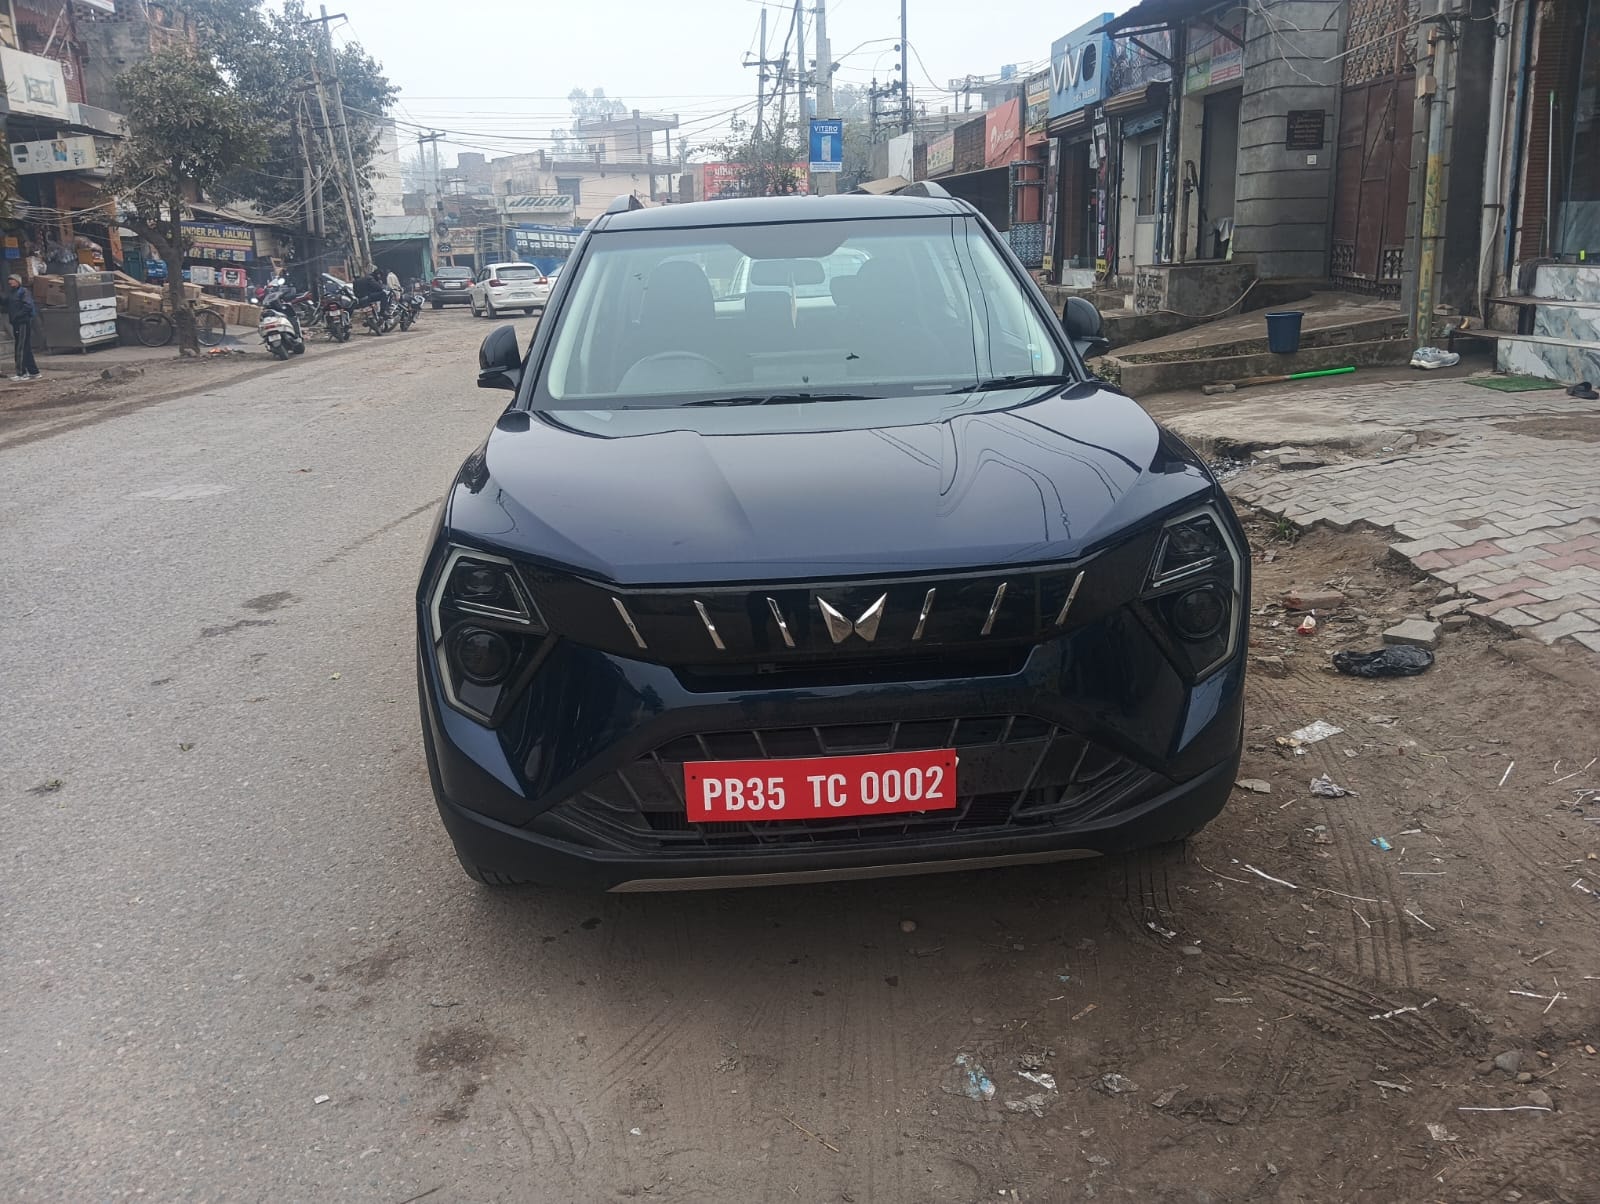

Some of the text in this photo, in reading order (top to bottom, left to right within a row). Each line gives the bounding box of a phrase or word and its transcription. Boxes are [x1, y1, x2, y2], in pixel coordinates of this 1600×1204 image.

[207, 228, 221, 238] PAL
[223, 229, 251, 239] HALWAI
[702, 765, 944, 811] PB35 TC 0002
